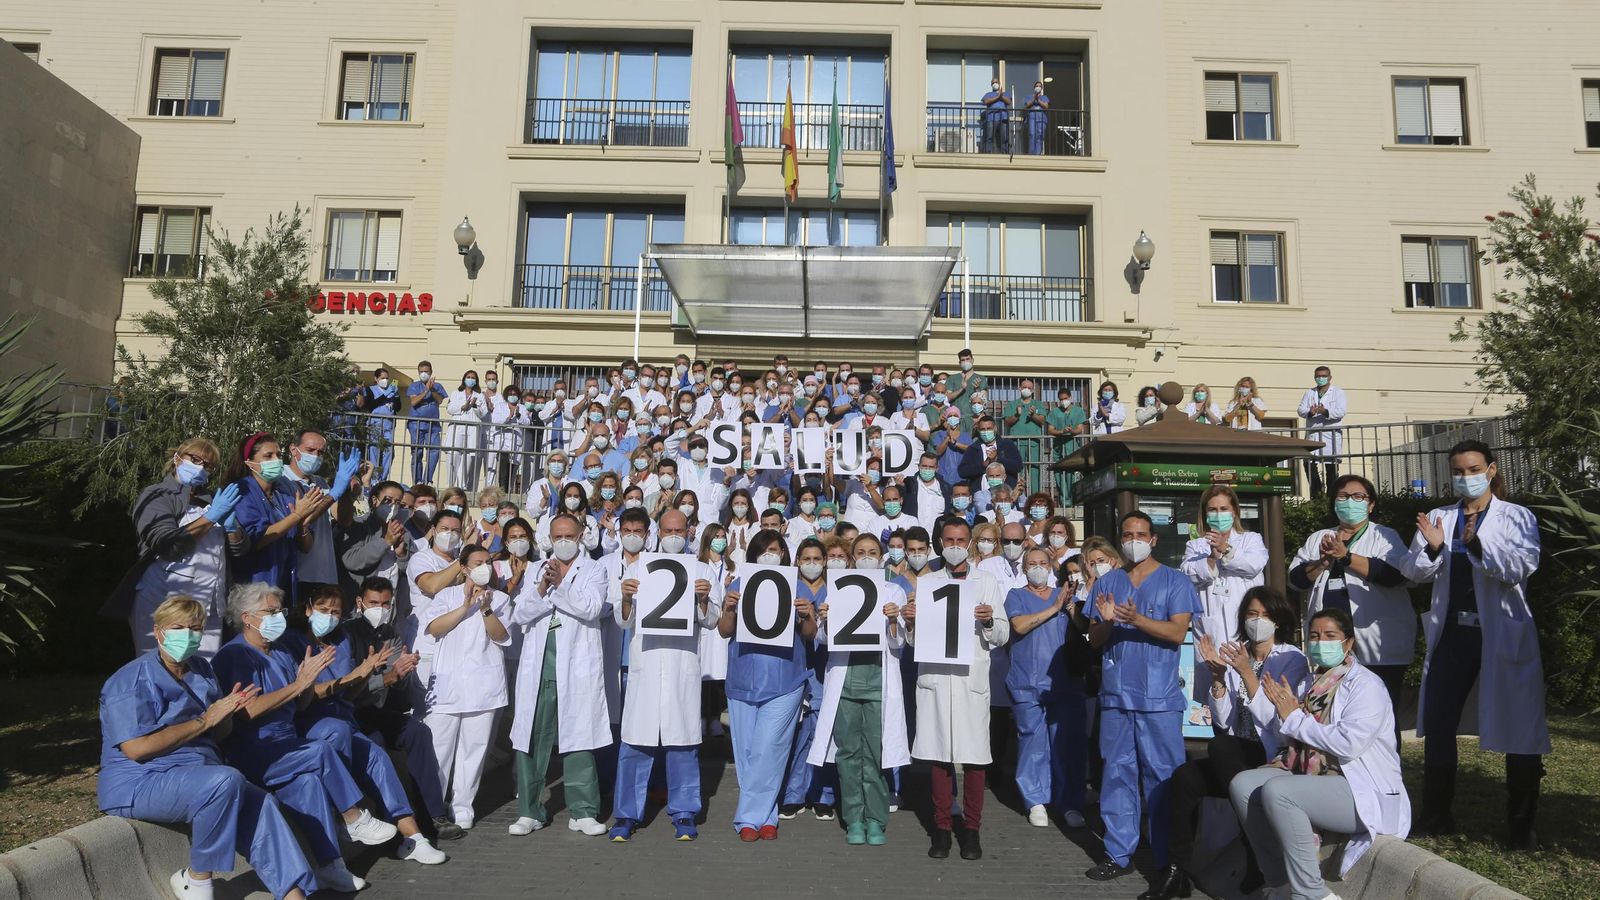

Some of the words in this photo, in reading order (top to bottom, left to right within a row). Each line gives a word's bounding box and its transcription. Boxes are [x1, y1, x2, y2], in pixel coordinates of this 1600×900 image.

[264, 291, 434, 313] GENCIAS
[1151, 468, 1177, 478] Cupón
[1177, 469, 1199, 478] Extra
[1152, 478, 1162, 486] de
